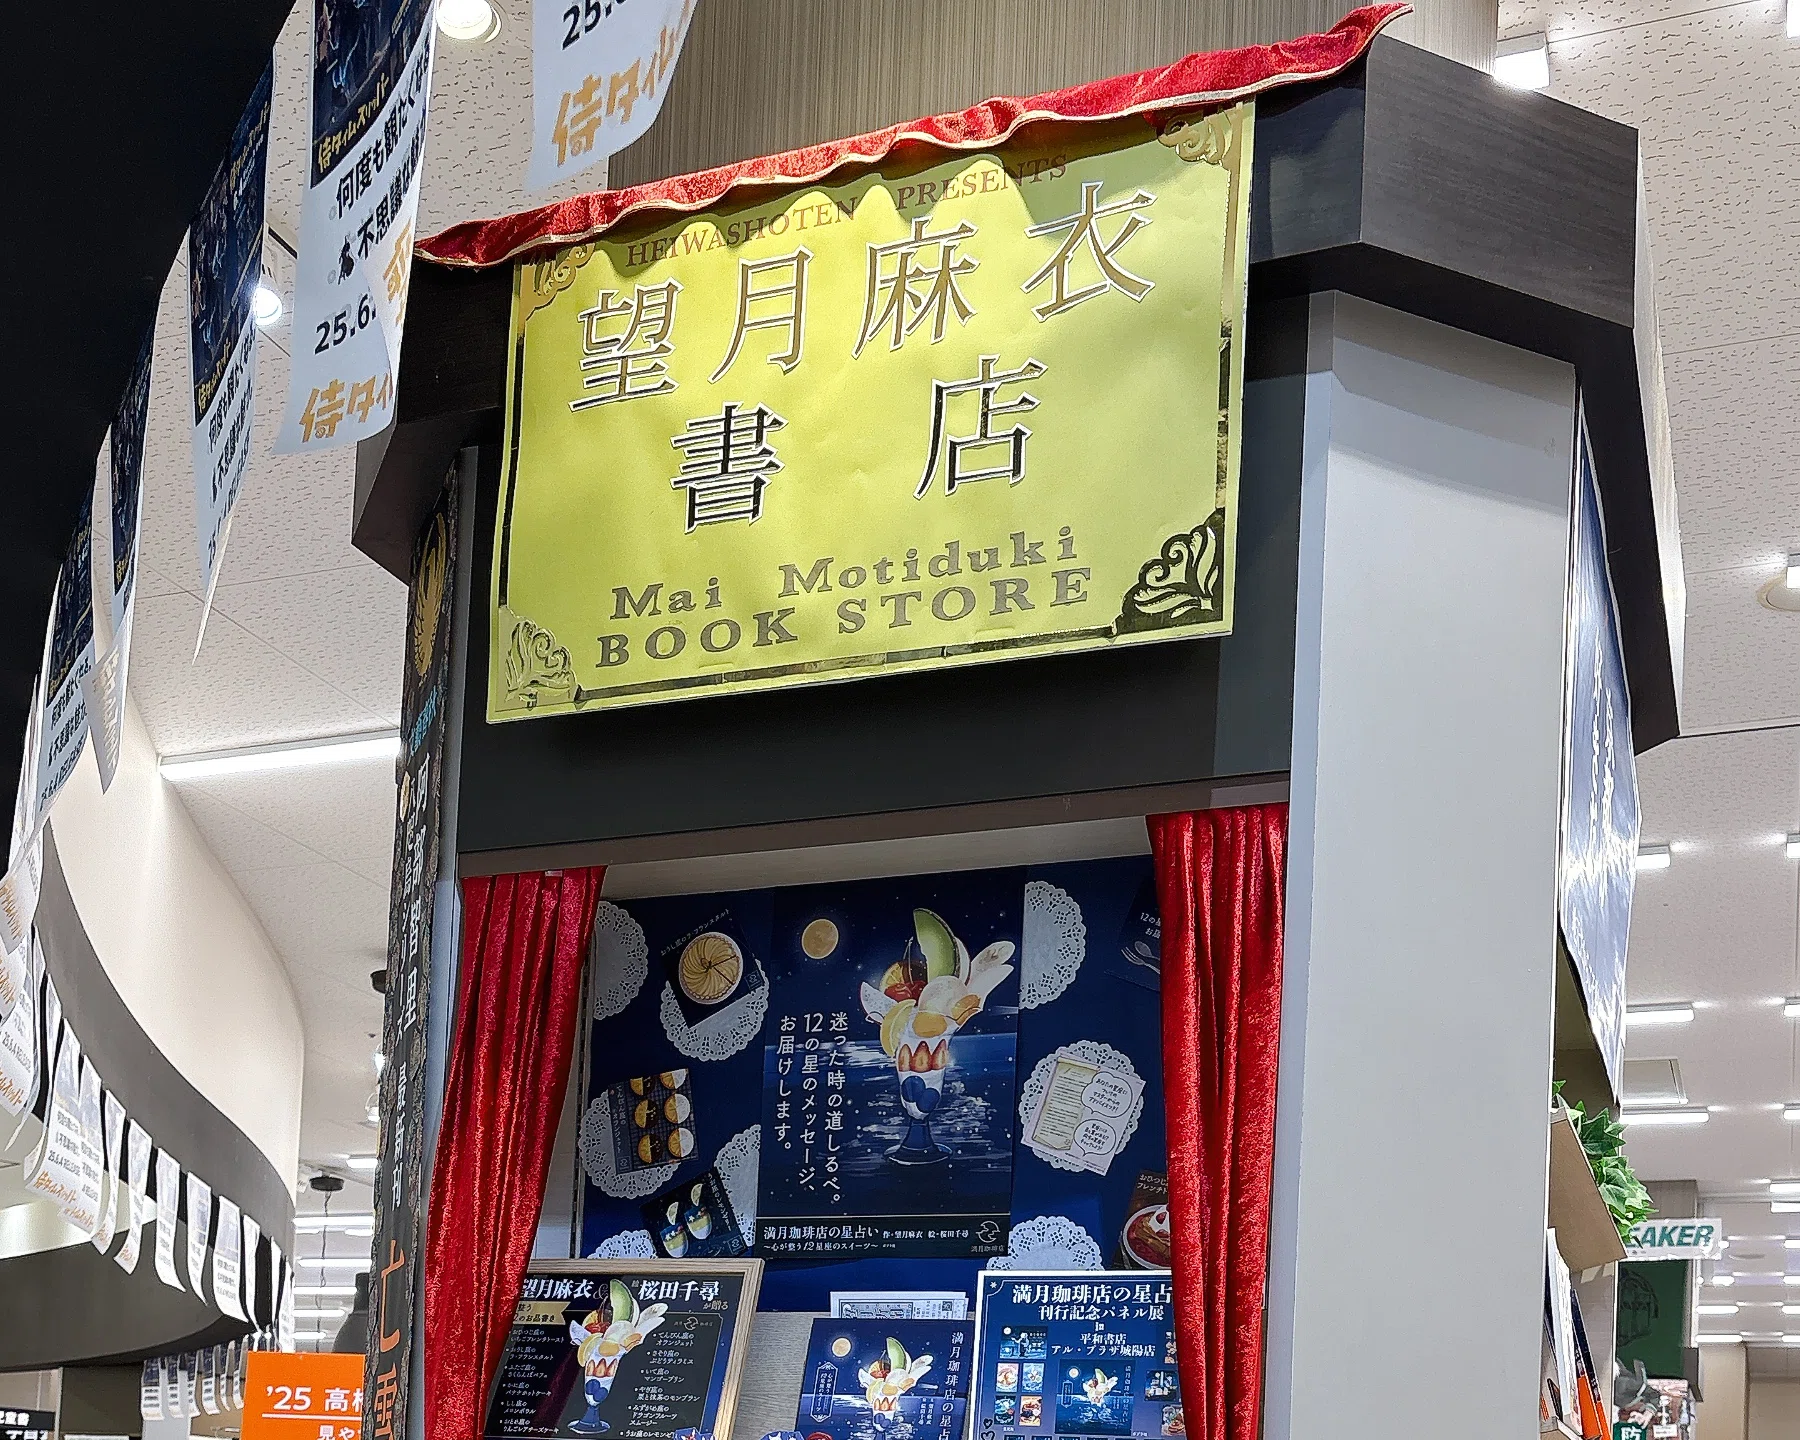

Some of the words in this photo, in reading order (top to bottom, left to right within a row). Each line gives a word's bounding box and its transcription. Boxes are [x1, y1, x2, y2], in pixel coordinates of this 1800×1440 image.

[626, 196, 858, 268] HEIWASHOTEN
[896, 153, 1069, 210] PRESENTS
[570, 181, 1157, 412] 望月麻衣
[669, 355, 1050, 534] 書店
[595, 606, 799, 670] BOOK
[837, 566, 1092, 634] STORE
[610, 577, 724, 620] Mai
[778, 525, 1078, 598] Motiduki
[774, 1014, 798, 1152] お届けします。
[798, 1012, 824, 1194] 12の星のメッセージ、
[823, 1011, 849, 1204] 迷った時の道しるべ。
[764, 1225, 879, 1240] 満月珈琲店の星占い
[638, 1280, 720, 1301] 桜田千尋
[1038, 1305, 1164, 1321] 刊行記念パネル展
[1080, 1333, 1127, 1345] 平和書店
[1095, 1322, 1105, 1332] in
[1051, 1344, 1156, 1357] アル・プラザ城陽店
